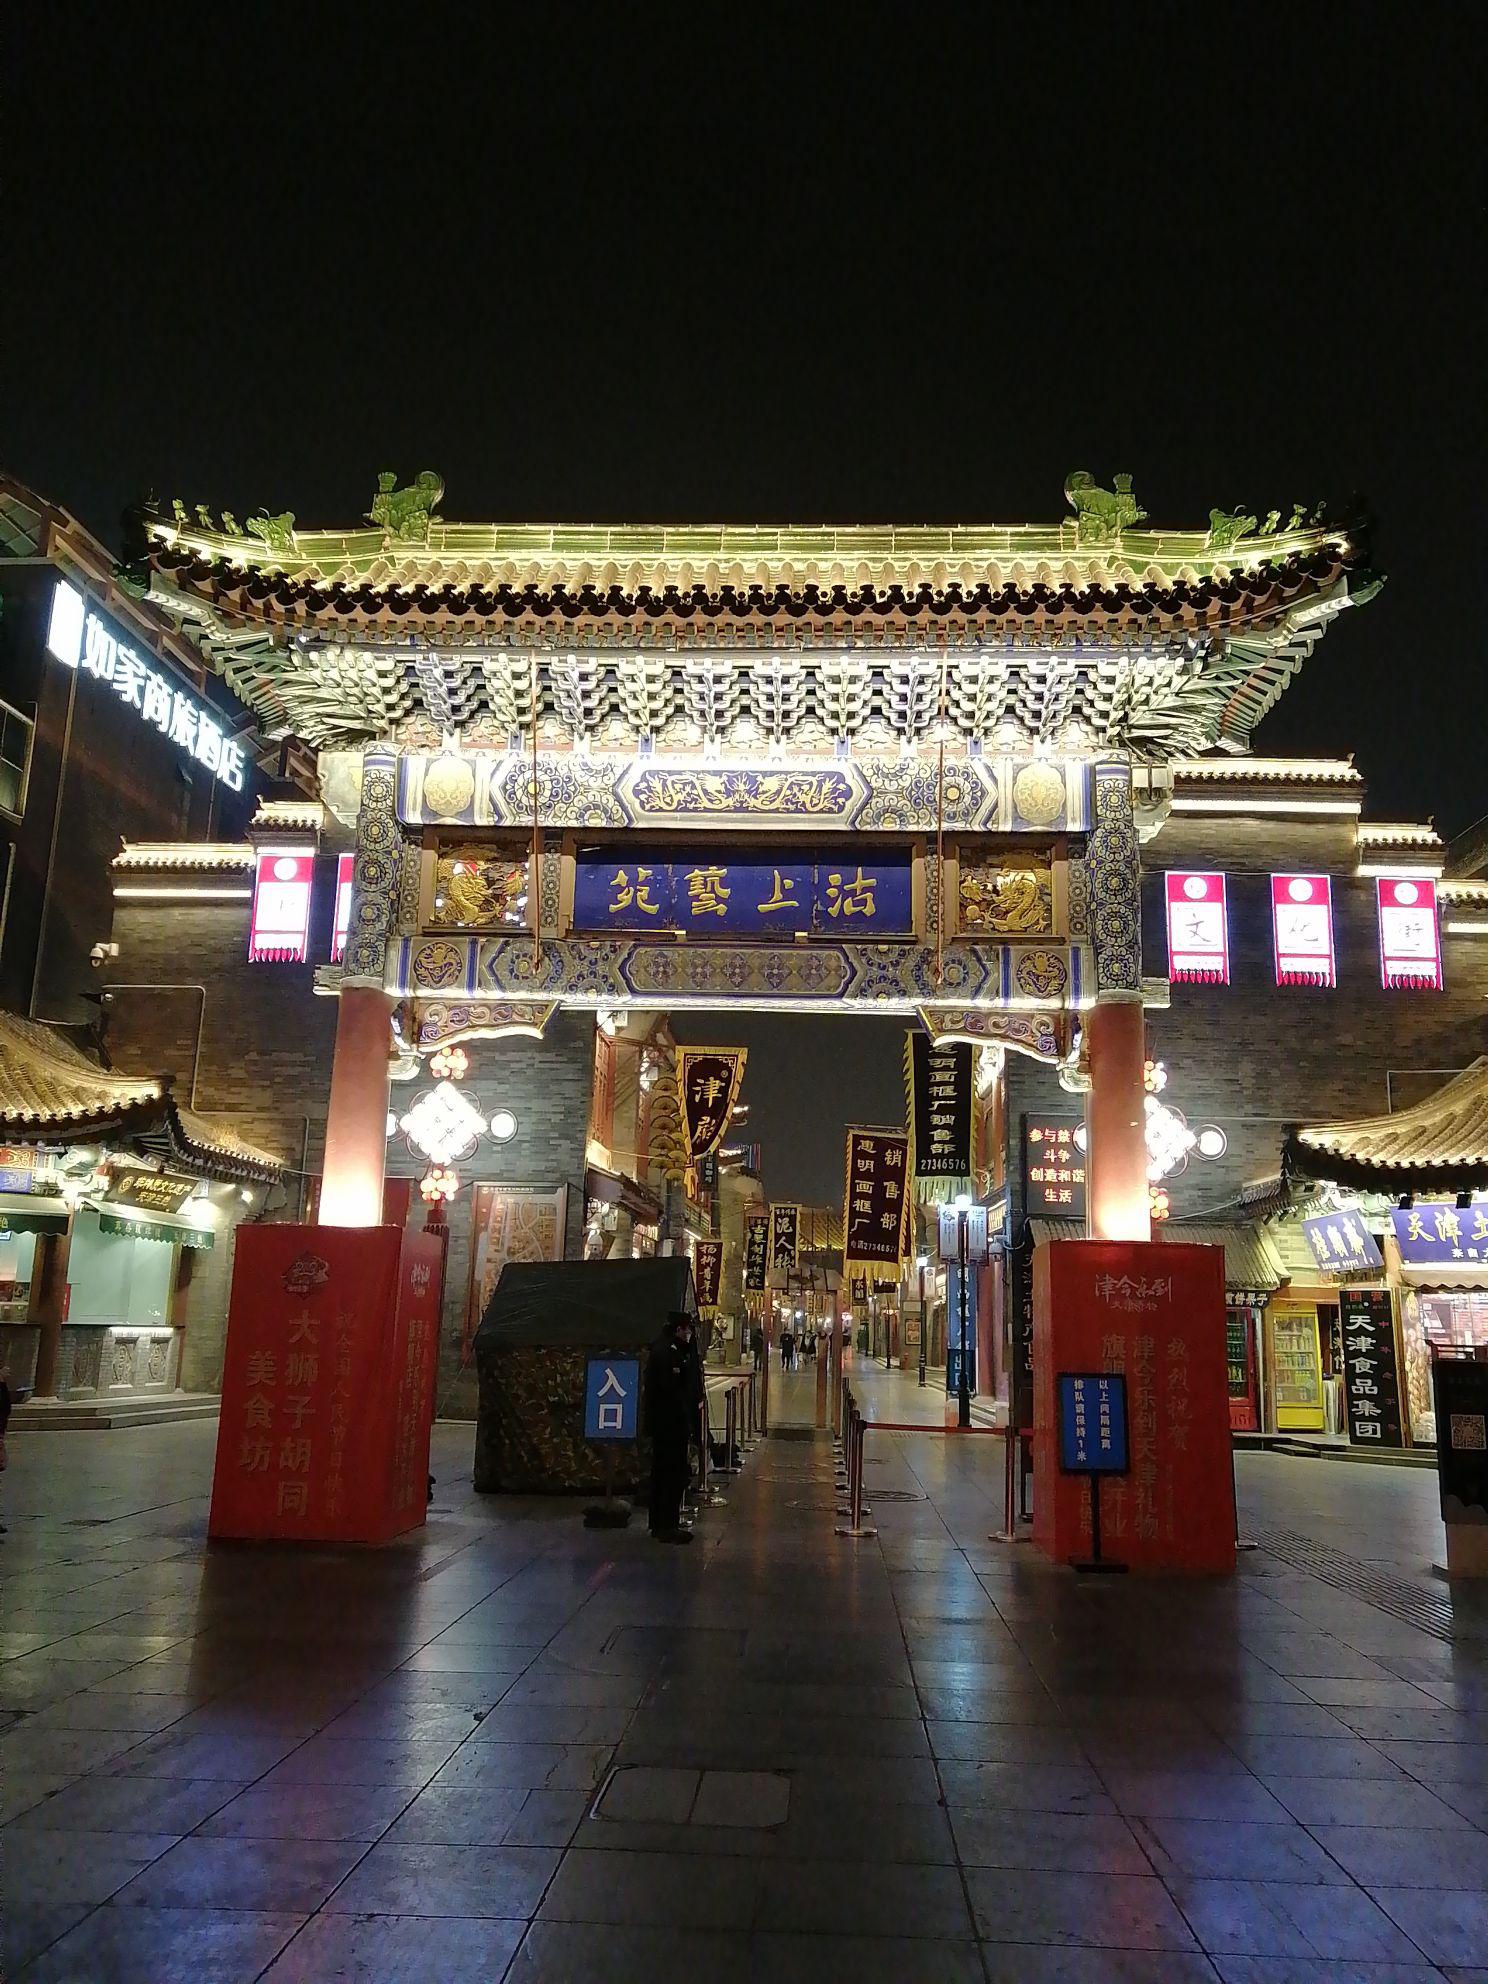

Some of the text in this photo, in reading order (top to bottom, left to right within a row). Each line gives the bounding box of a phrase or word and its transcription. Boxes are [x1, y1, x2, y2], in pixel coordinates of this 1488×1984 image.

[82, 613, 244, 792] 如家商旅酒店
[921, 1159, 966, 1170] 27346576
[1029, 1128, 1074, 1143] 参与禁
[1043, 1148, 1072, 1163] 斗争
[880, 1149, 903, 1231] 销售部
[1030, 1167, 1086, 1183] 创造和谐
[1044, 1188, 1073, 1203] 生活
[597, 1367, 627, 1429] 入口
[1345, 1315, 1382, 1439] 天津食品集团
[240, 1350, 278, 1477] 美食坊
[276, 1309, 321, 1518] 大狮子胡同
[1073, 1379, 1087, 1462] 排队请保持1米
[1099, 1379, 1111, 1449] 以上间隔距离
